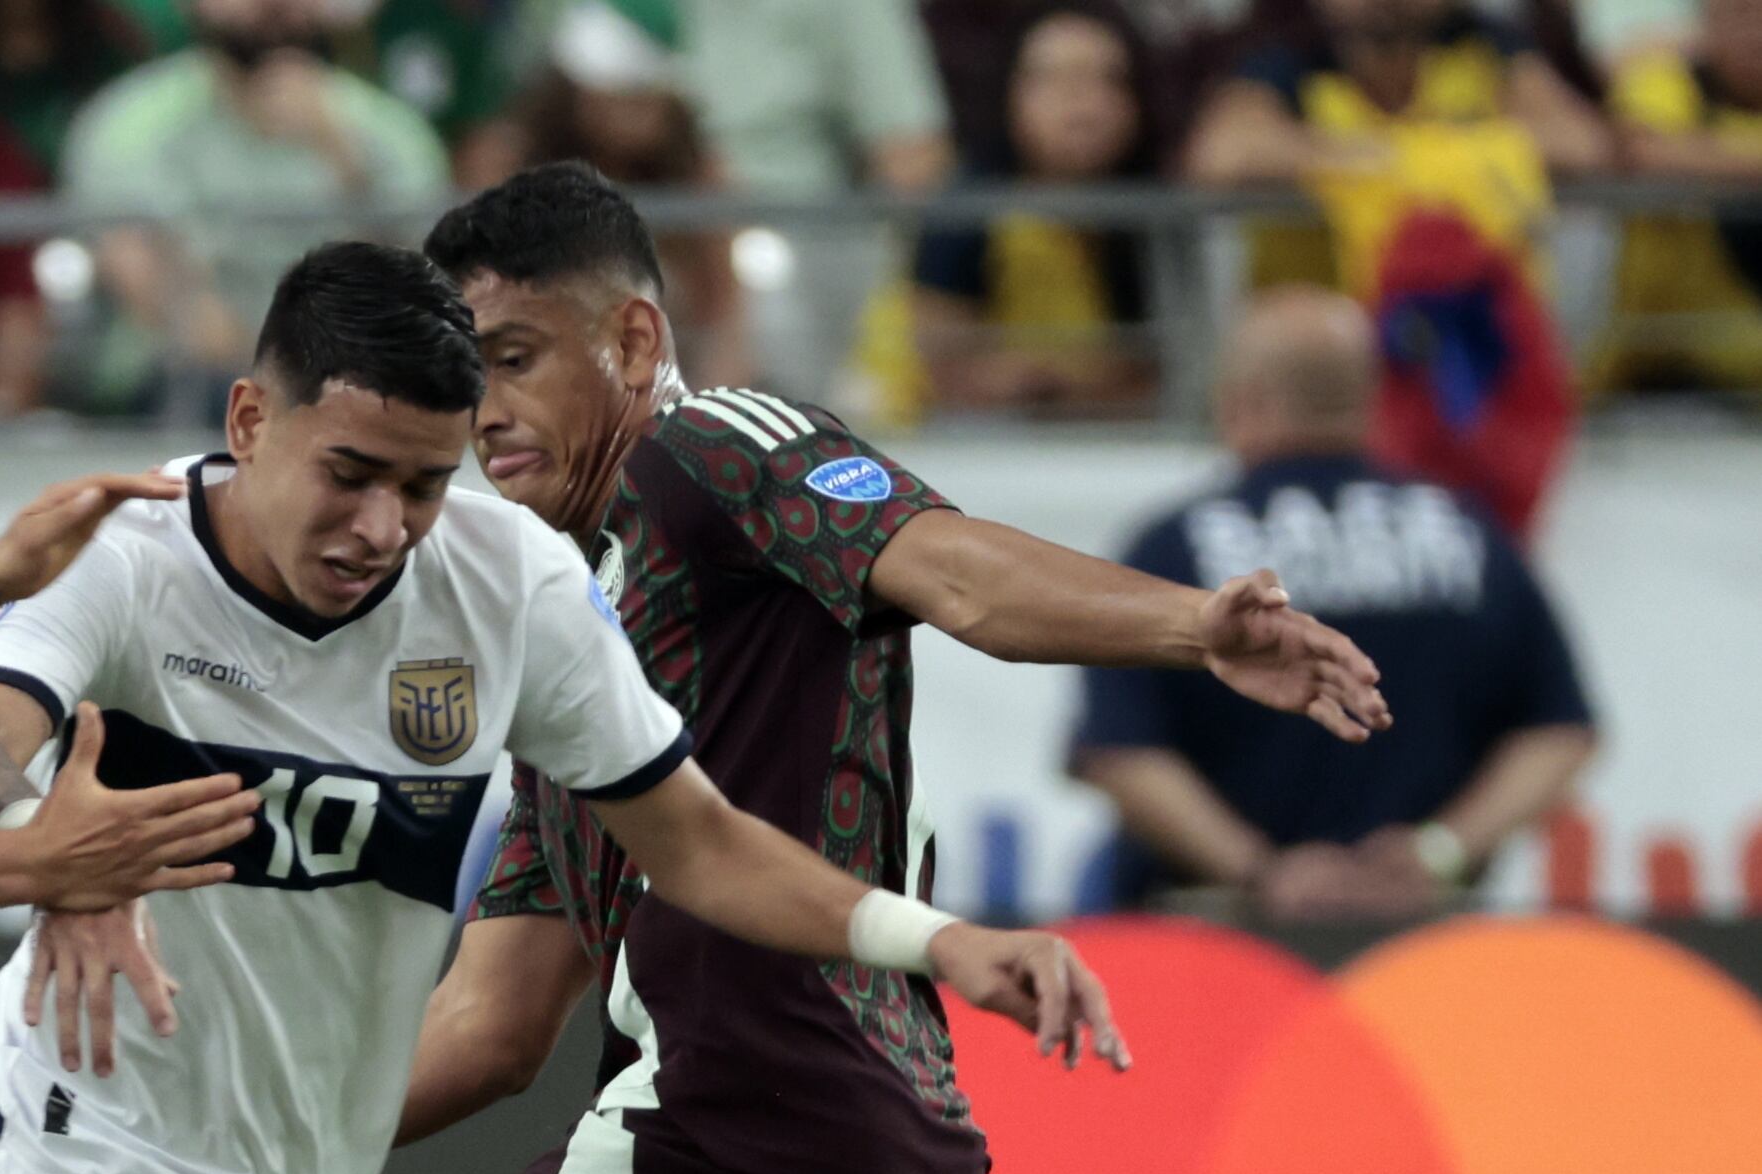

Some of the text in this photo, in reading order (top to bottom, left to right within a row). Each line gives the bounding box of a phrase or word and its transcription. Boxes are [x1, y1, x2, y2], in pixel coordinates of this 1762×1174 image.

[824, 463, 873, 490] VIBRA
[161, 652, 266, 692] marath
[258, 767, 380, 878] 10
